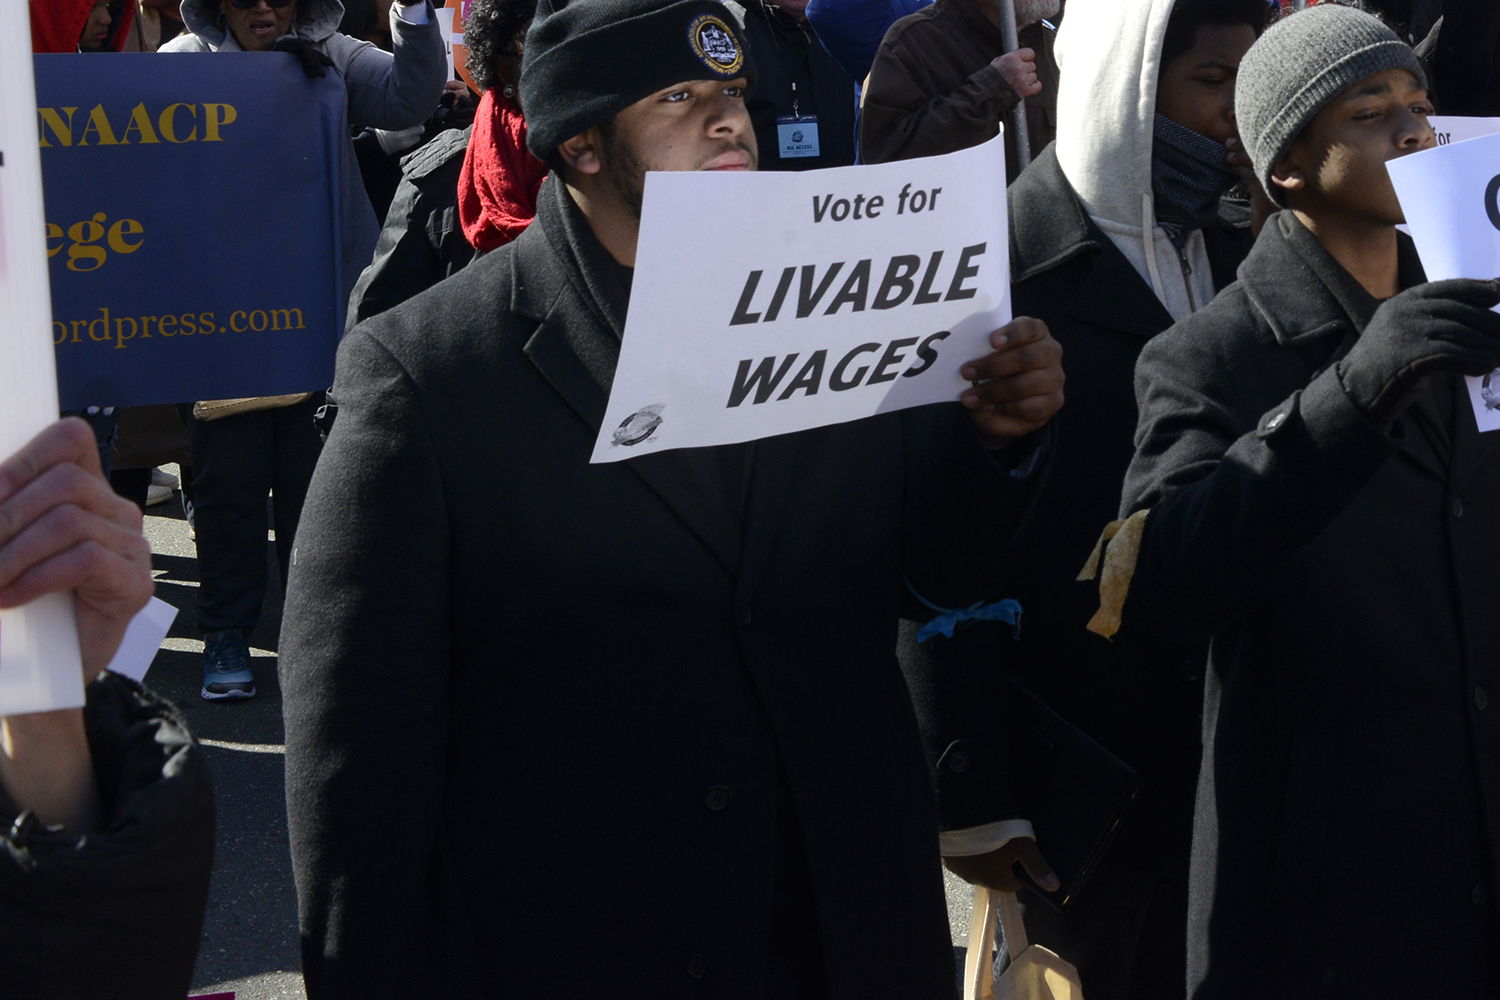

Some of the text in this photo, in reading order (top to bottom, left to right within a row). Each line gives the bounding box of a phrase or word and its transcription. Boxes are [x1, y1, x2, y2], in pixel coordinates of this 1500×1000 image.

[37, 101, 238, 148] NAACP
[813, 183, 942, 223] Vote for
[729, 241, 987, 327] LIVABLE
[52, 305, 307, 349] ordpress.com
[726, 330, 951, 409] WAGES
